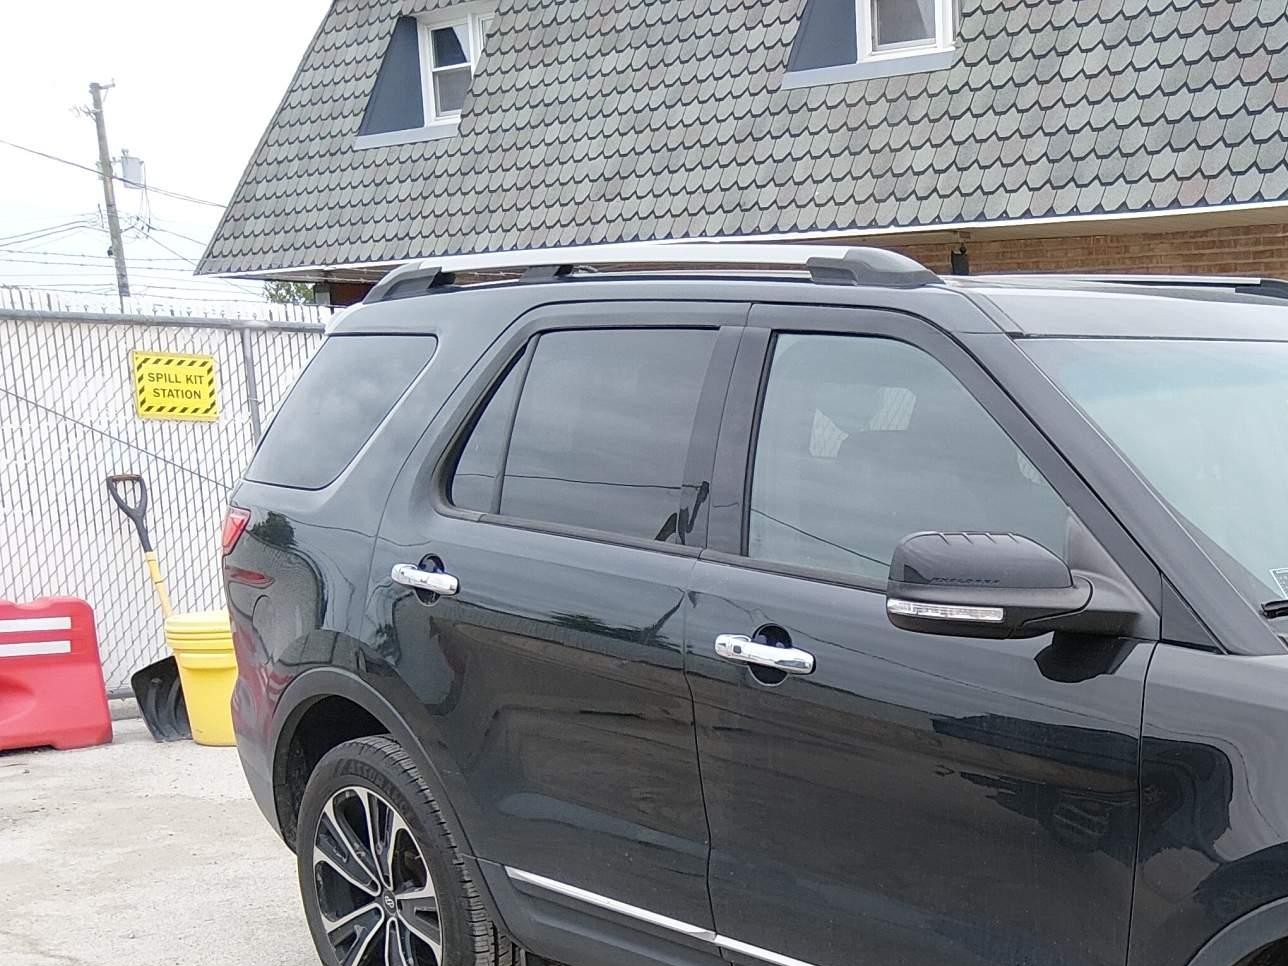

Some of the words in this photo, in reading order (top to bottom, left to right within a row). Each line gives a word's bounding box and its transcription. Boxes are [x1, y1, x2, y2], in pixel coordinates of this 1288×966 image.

[147, 372, 182, 384] SPILL
[185, 374, 204, 385] KIT
[152, 388, 202, 400] STATION
